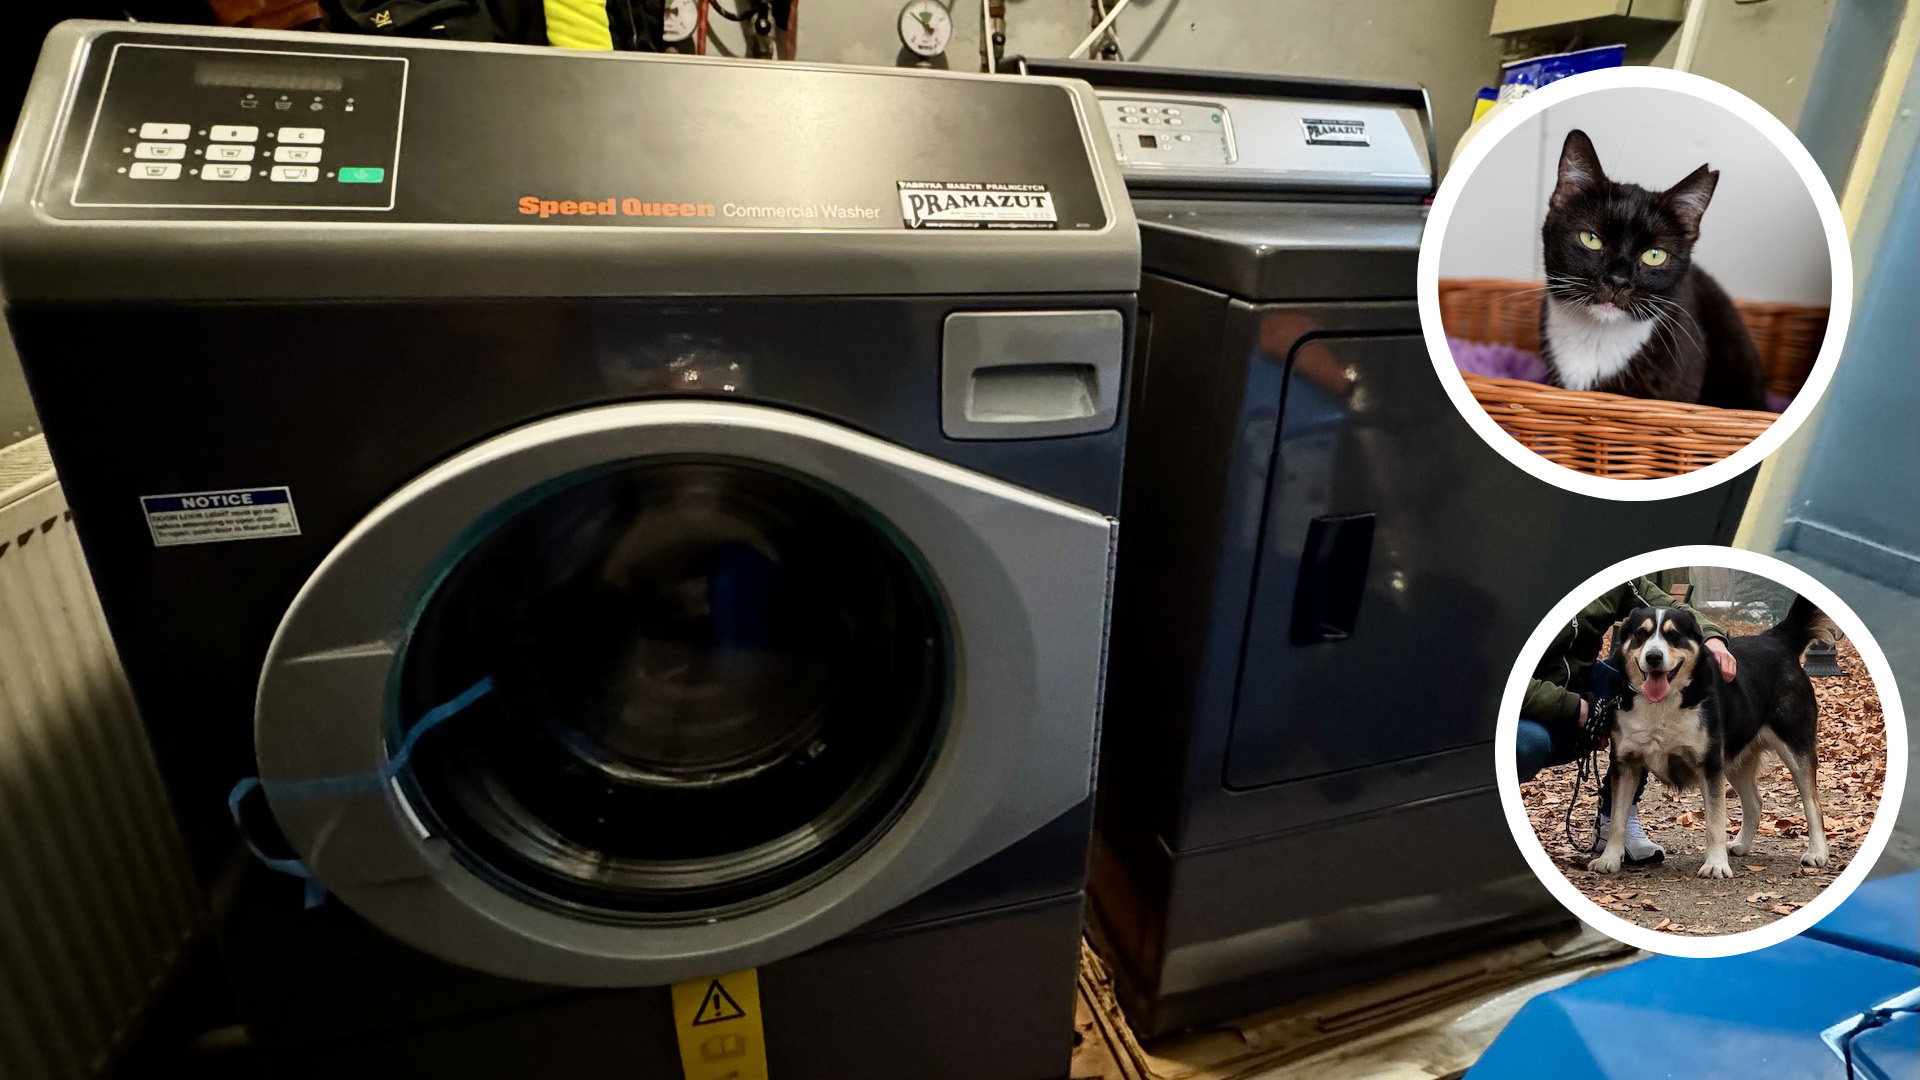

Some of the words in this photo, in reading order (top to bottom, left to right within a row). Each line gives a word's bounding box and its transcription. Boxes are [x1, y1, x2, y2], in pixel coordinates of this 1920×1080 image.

[1306, 125, 1364, 140] PRAMAZUT
[898, 181, 943, 190] FABRYKA
[986, 184, 1046, 192] PRALNICZYCH
[519, 196, 617, 218] Speed
[621, 198, 716, 217] Queen
[723, 203, 818, 219] Commercial
[822, 205, 880, 219] Washer
[908, 194, 1046, 221] PRAMAZUT
[181, 493, 254, 509] NOTICE
